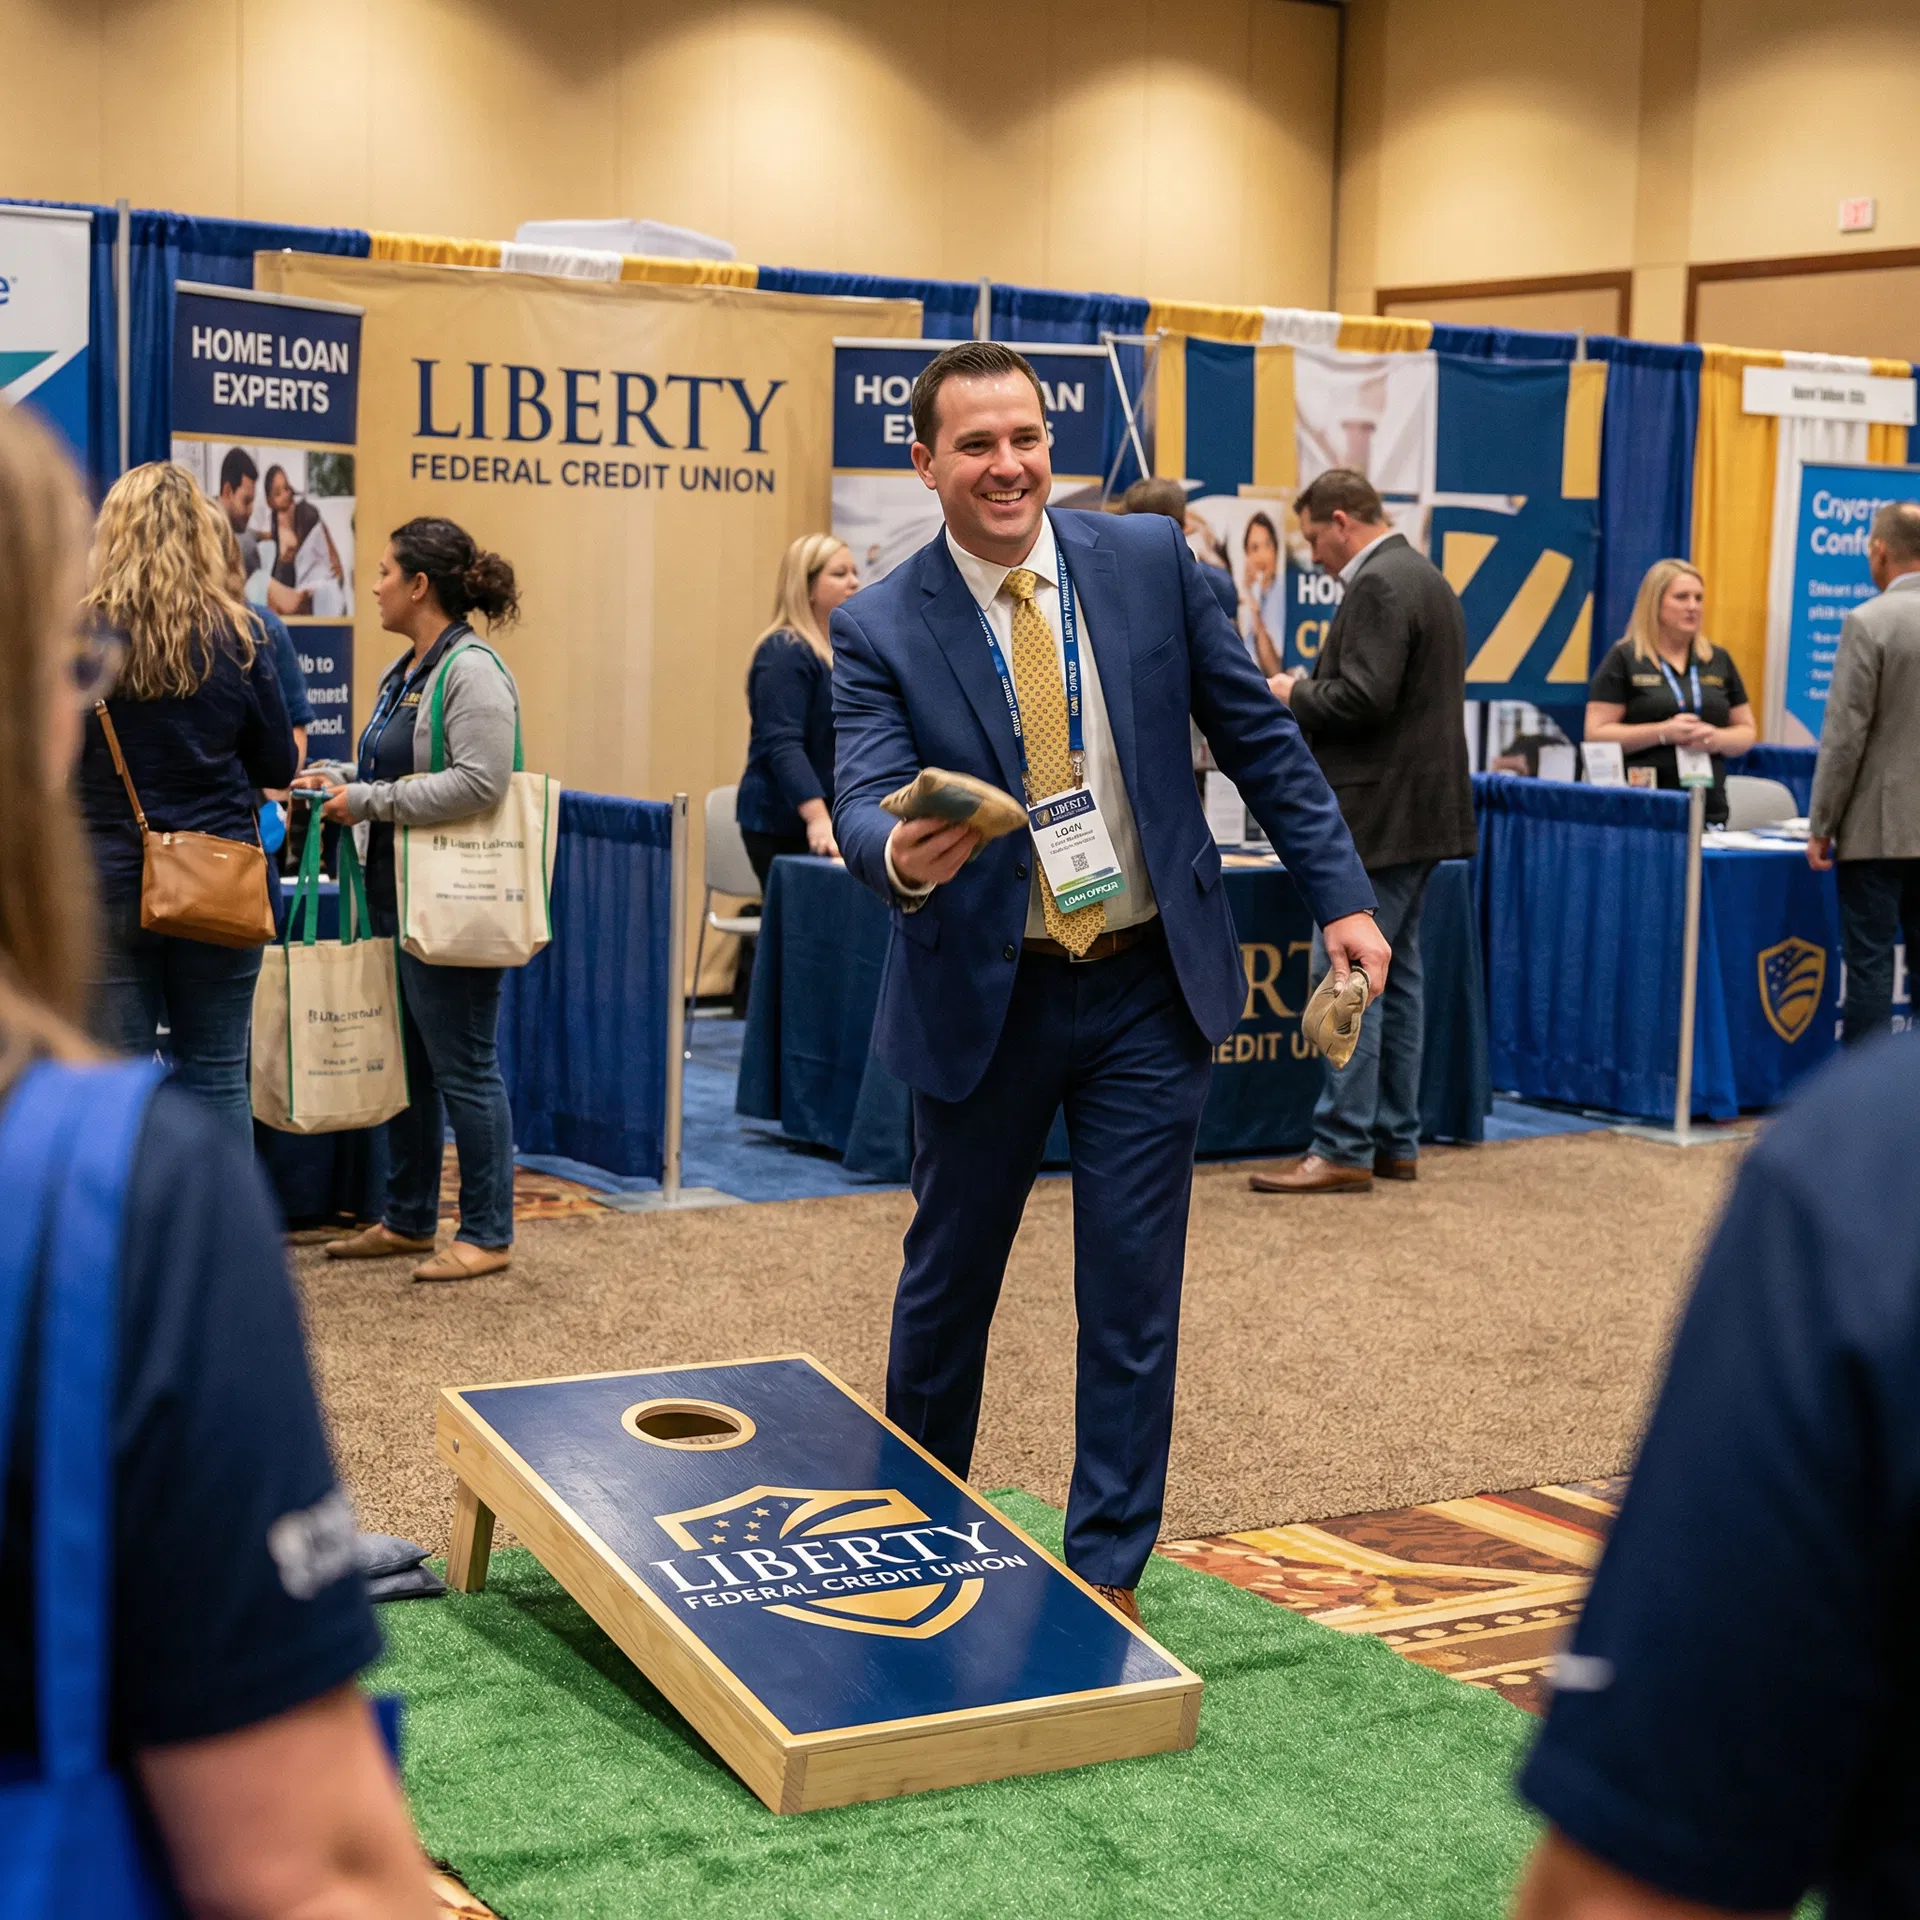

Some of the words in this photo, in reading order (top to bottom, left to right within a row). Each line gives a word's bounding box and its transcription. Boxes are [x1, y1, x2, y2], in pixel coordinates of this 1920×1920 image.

[191, 325, 273, 367] HOME
[278, 335, 349, 375] LOAN
[213, 371, 330, 414] EXPERTS
[411, 358, 788, 454] LIBERTY
[854, 374, 916, 405] HO
[411, 453, 551, 486] FEDERAL
[560, 460, 670, 491] CREDIT
[679, 465, 775, 494] UNION
[649, 1520, 999, 1594] LIBERTY
[684, 1581, 819, 1610] FEDERAL
[822, 1566, 923, 1591] CREDIT
[930, 1554, 1029, 1578] UNION
